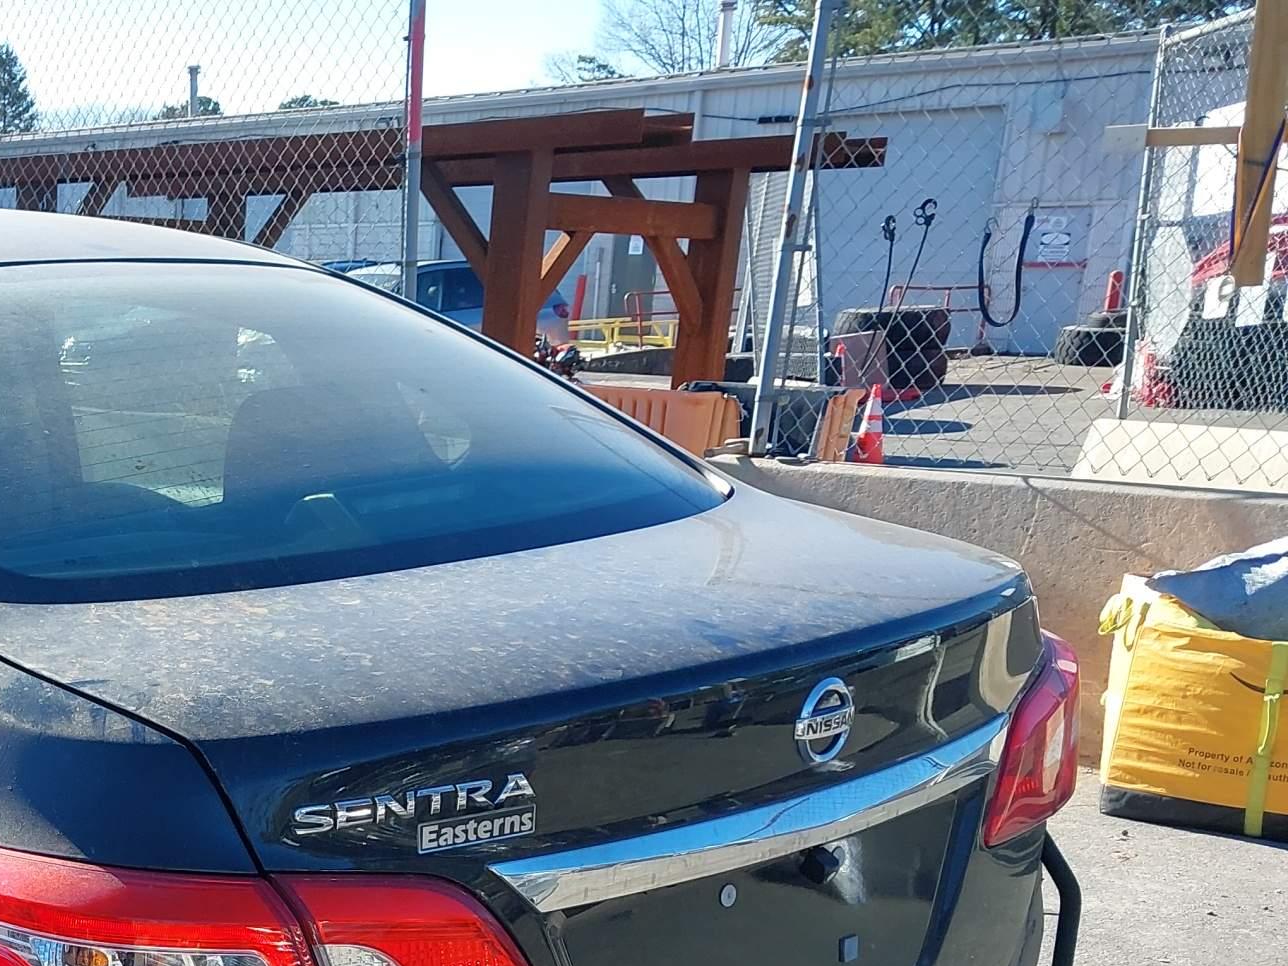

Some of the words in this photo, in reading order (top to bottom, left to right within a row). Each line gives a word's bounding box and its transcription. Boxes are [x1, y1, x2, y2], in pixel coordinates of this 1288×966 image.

[806, 709, 854, 736] NISSAN
[1178, 759, 1195, 769] Not
[1198, 761, 1212, 771] for
[1188, 747, 1230, 763] Property
[1233, 755, 1243, 763] of
[294, 773, 537, 835] SENTRA
[421, 811, 534, 849] Easterns
